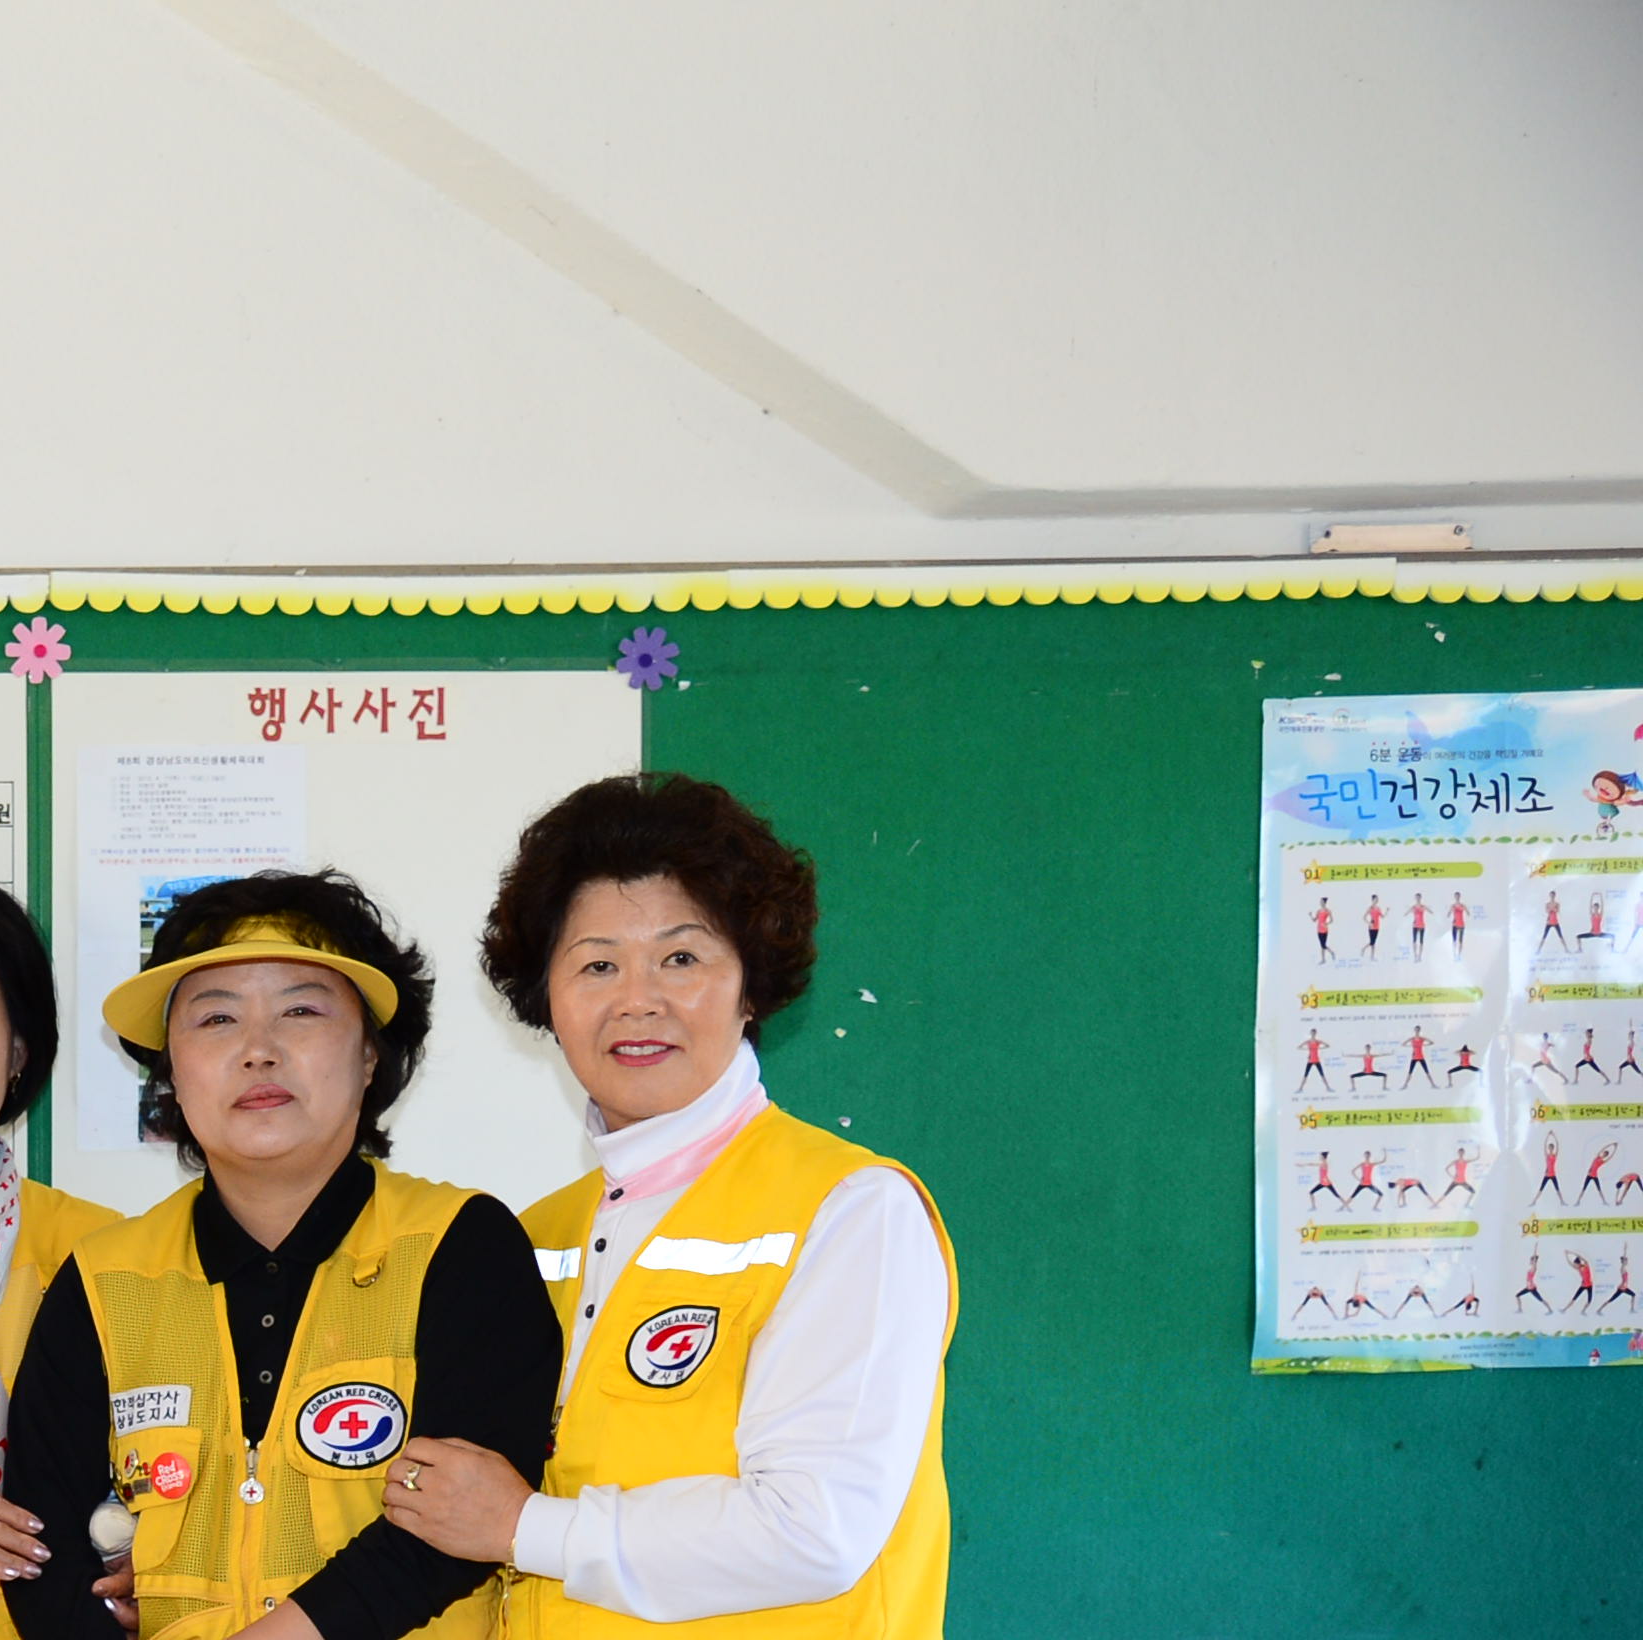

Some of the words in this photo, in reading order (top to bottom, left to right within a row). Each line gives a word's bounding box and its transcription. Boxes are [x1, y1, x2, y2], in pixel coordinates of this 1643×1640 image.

[646, 1313, 689, 1335] KOREAN
[307, 1390, 344, 1417] KOREAN
[345, 1388, 366, 1397] RED
[368, 1389, 398, 1412] CROSS
